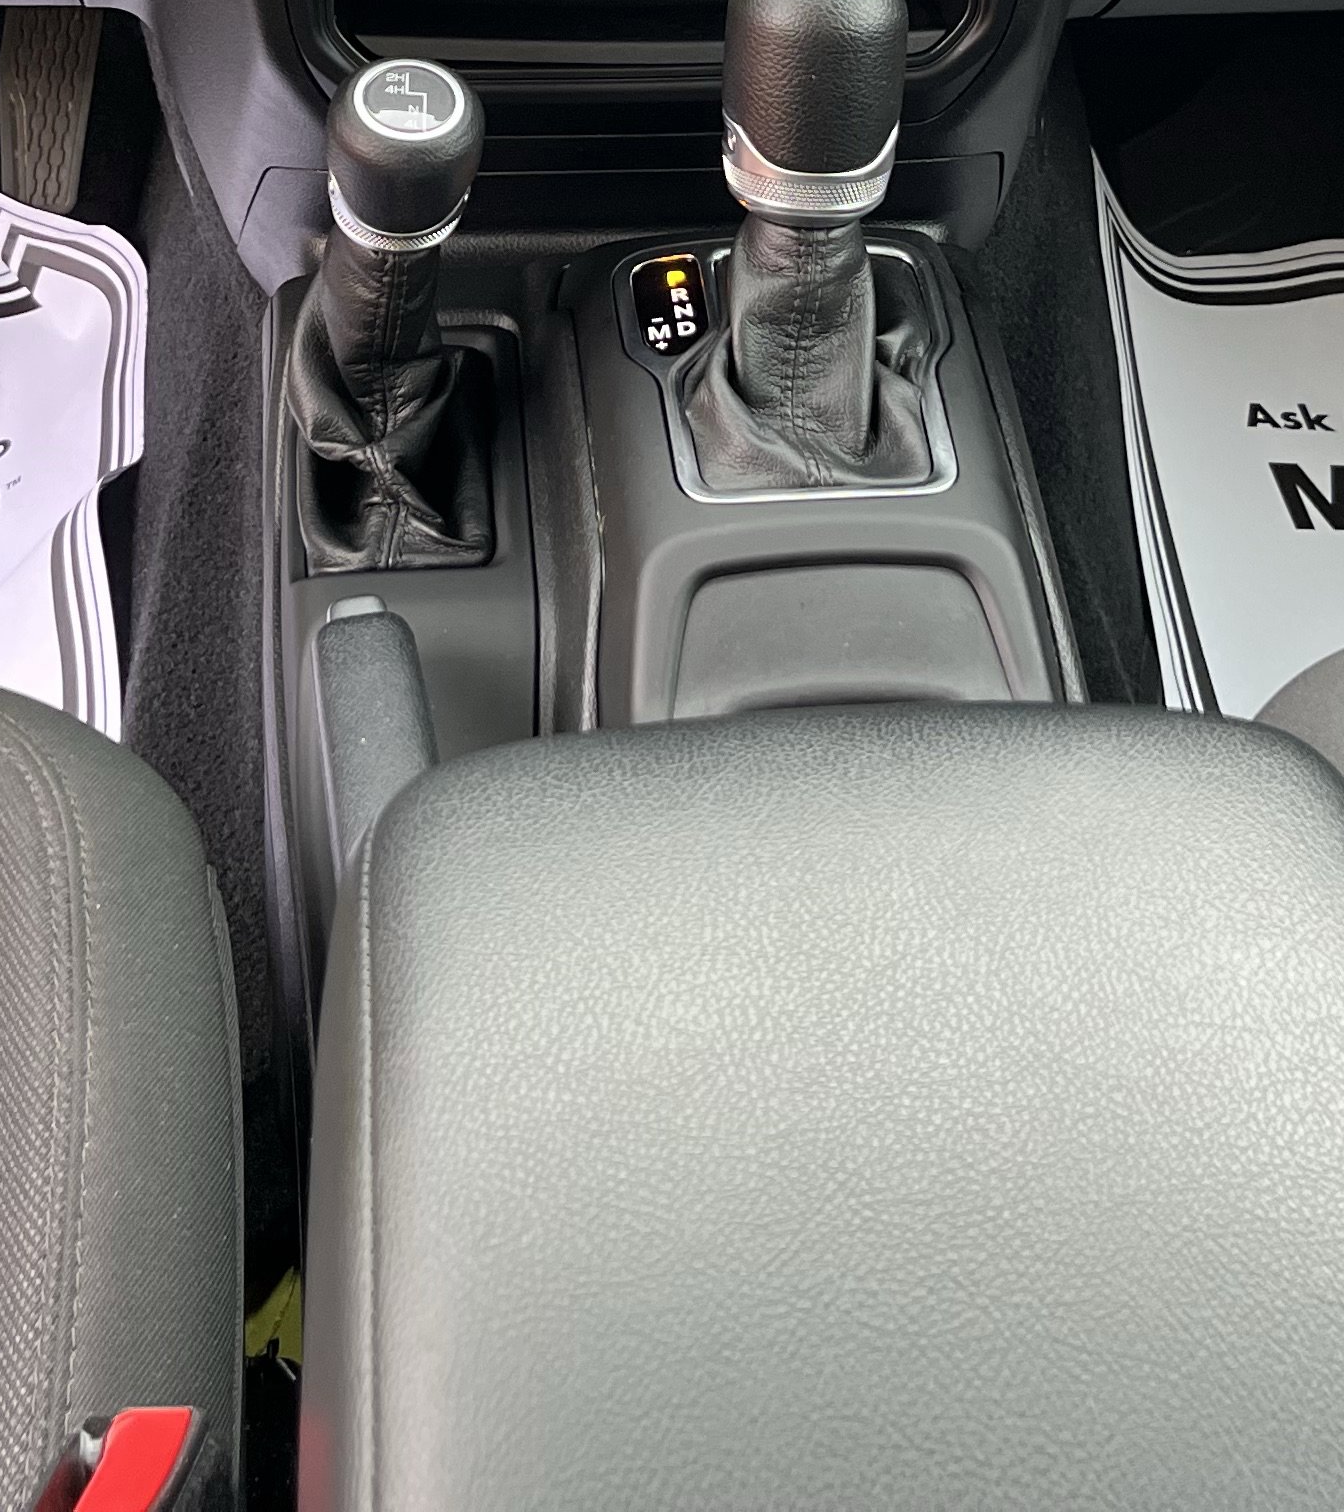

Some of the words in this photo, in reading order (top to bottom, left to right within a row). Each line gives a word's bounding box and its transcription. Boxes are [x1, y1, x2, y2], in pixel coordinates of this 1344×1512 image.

[385, 72, 406, 83] 2H
[385, 84, 404, 95] 4H
[671, 288, 689, 303] R
[673, 303, 694, 319] N
[648, 324, 672, 341] M
[676, 321, 696, 337] D
[1246, 402, 1335, 432] Ask
